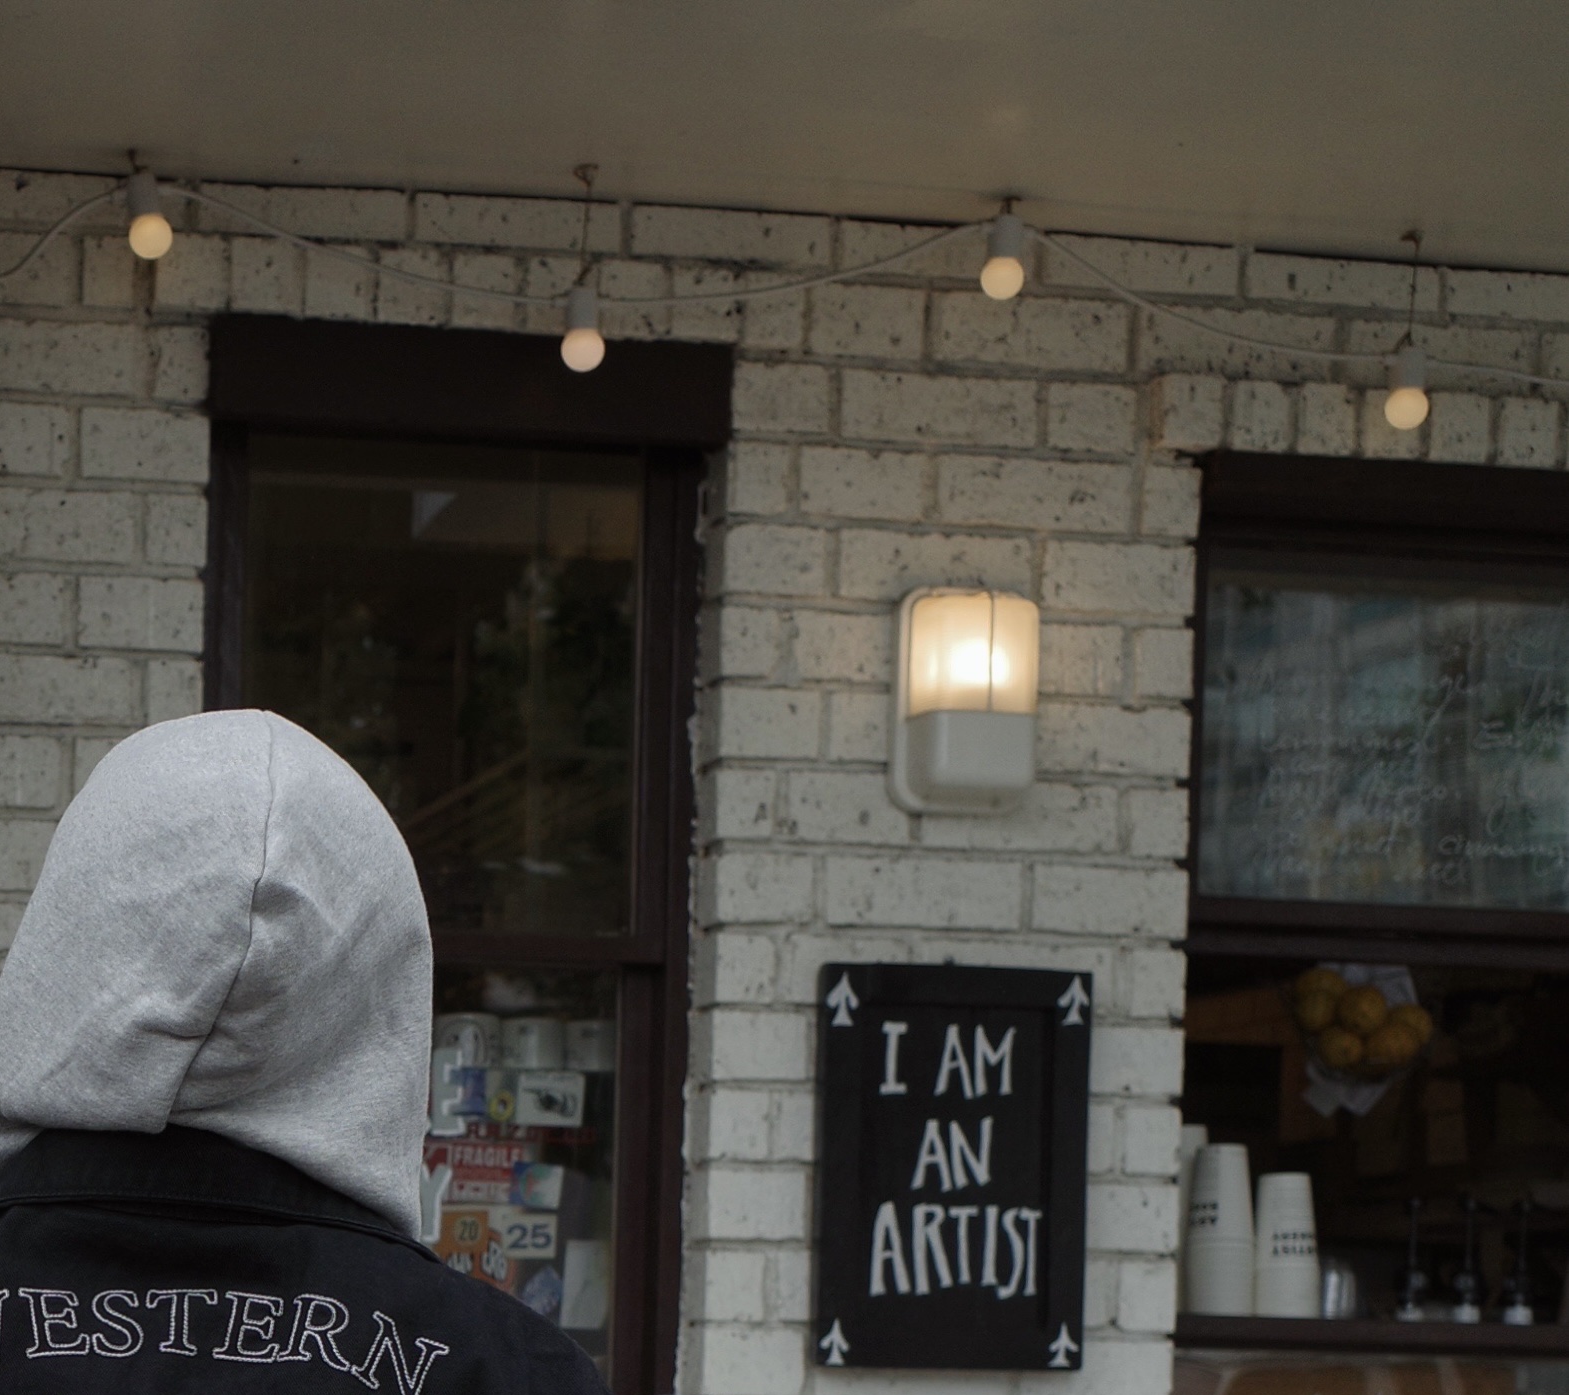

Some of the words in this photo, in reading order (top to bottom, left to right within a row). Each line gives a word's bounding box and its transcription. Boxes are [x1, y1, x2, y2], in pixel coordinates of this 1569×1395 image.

[879, 1021, 908, 1095] I
[933, 1023, 1017, 1100] AM
[911, 1116, 994, 1193] AN
[507, 1222, 552, 1249] 25
[869, 1201, 1043, 1301] ARTIST
